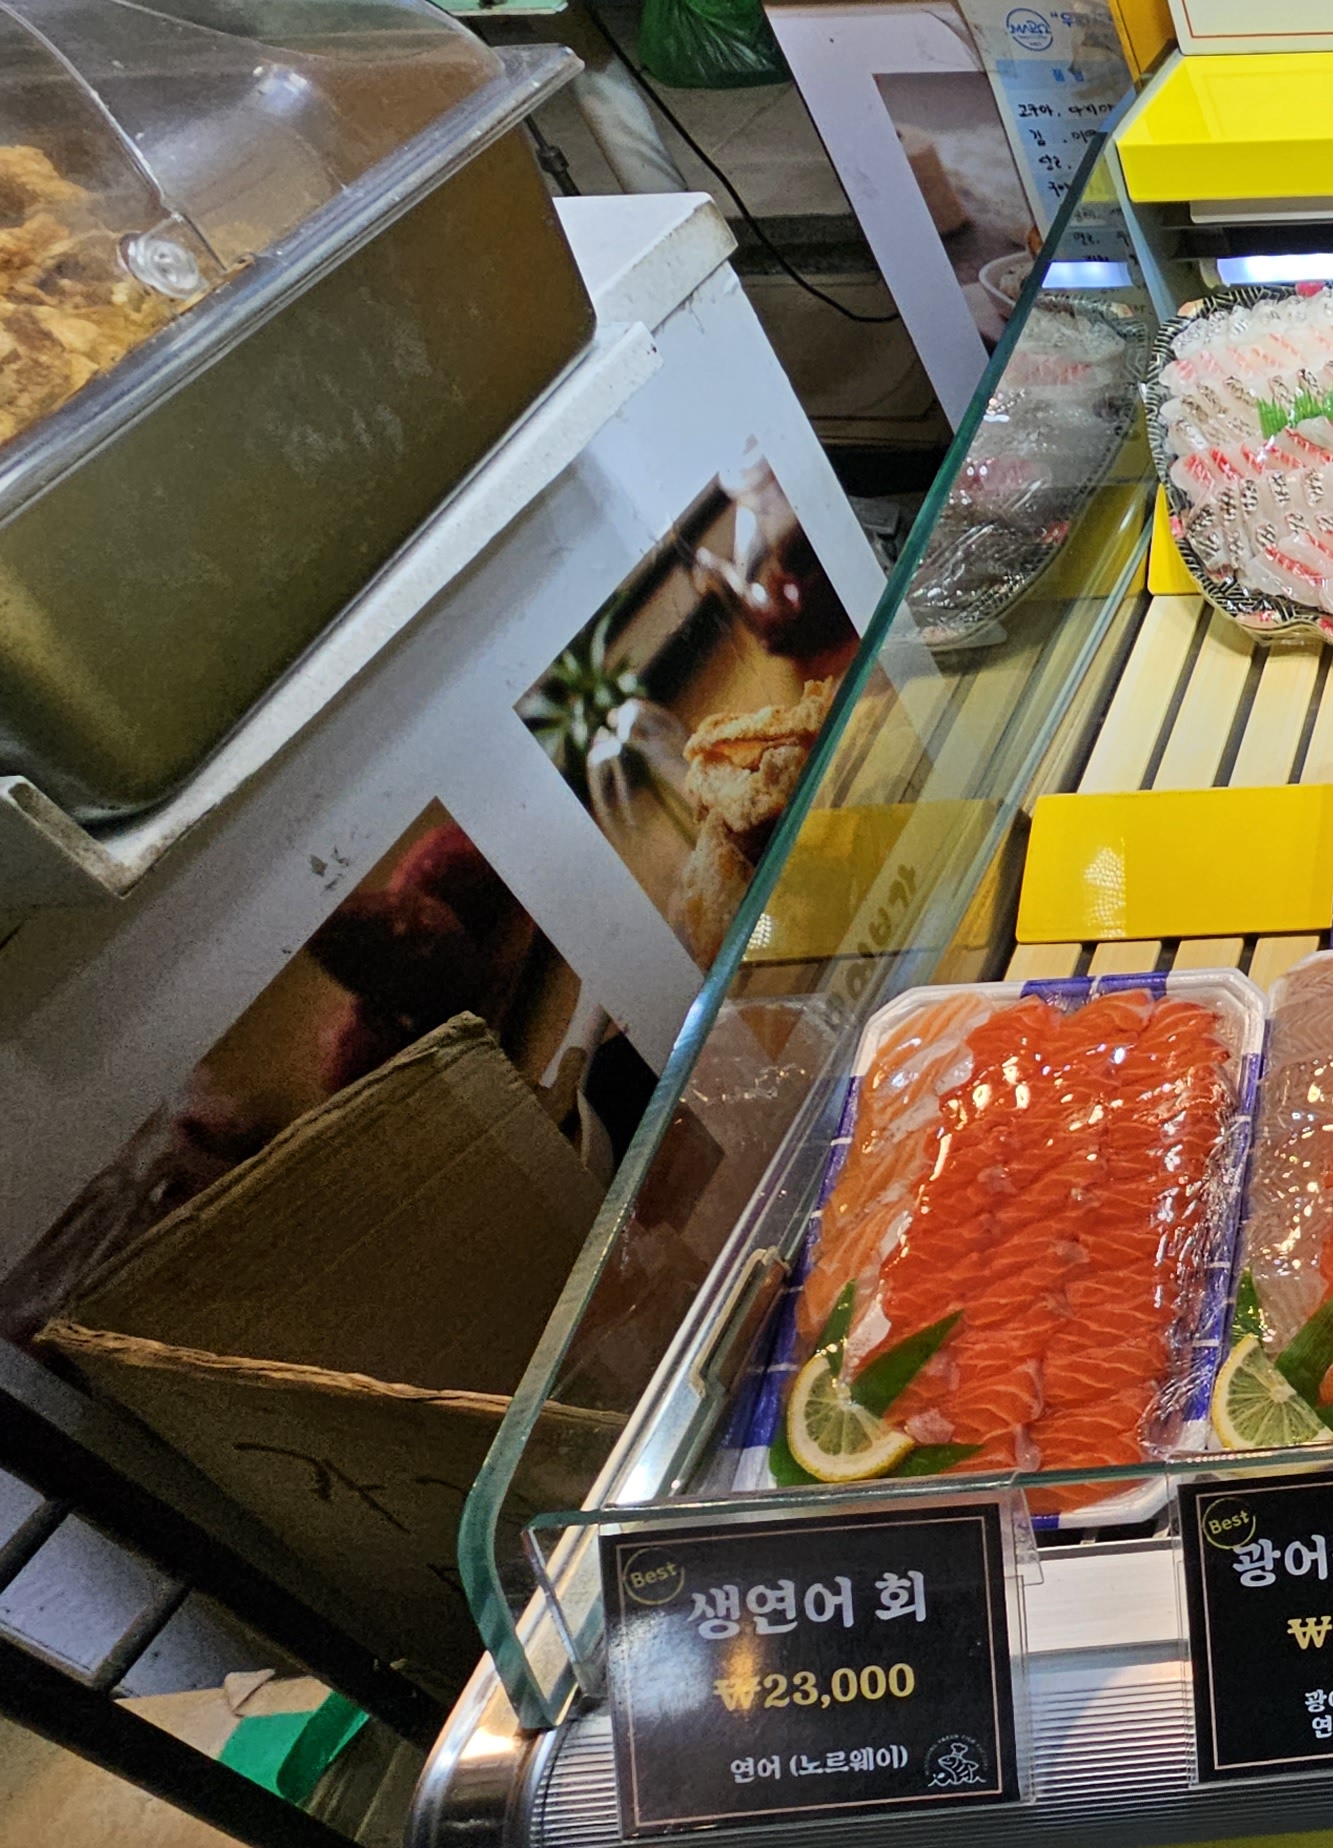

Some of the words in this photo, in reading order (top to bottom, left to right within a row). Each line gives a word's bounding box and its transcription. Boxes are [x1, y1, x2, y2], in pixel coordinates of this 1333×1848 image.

[1208, 1509, 1250, 1536] Best
[630, 1561, 678, 1589] Best
[687, 1576, 854, 1641] 생연어
[874, 1570, 927, 1623] 회
[713, 1663, 915, 1712] ₩23,000
[730, 1756, 782, 1785] 연어
[790, 1744, 909, 1778] (노르웨이)
